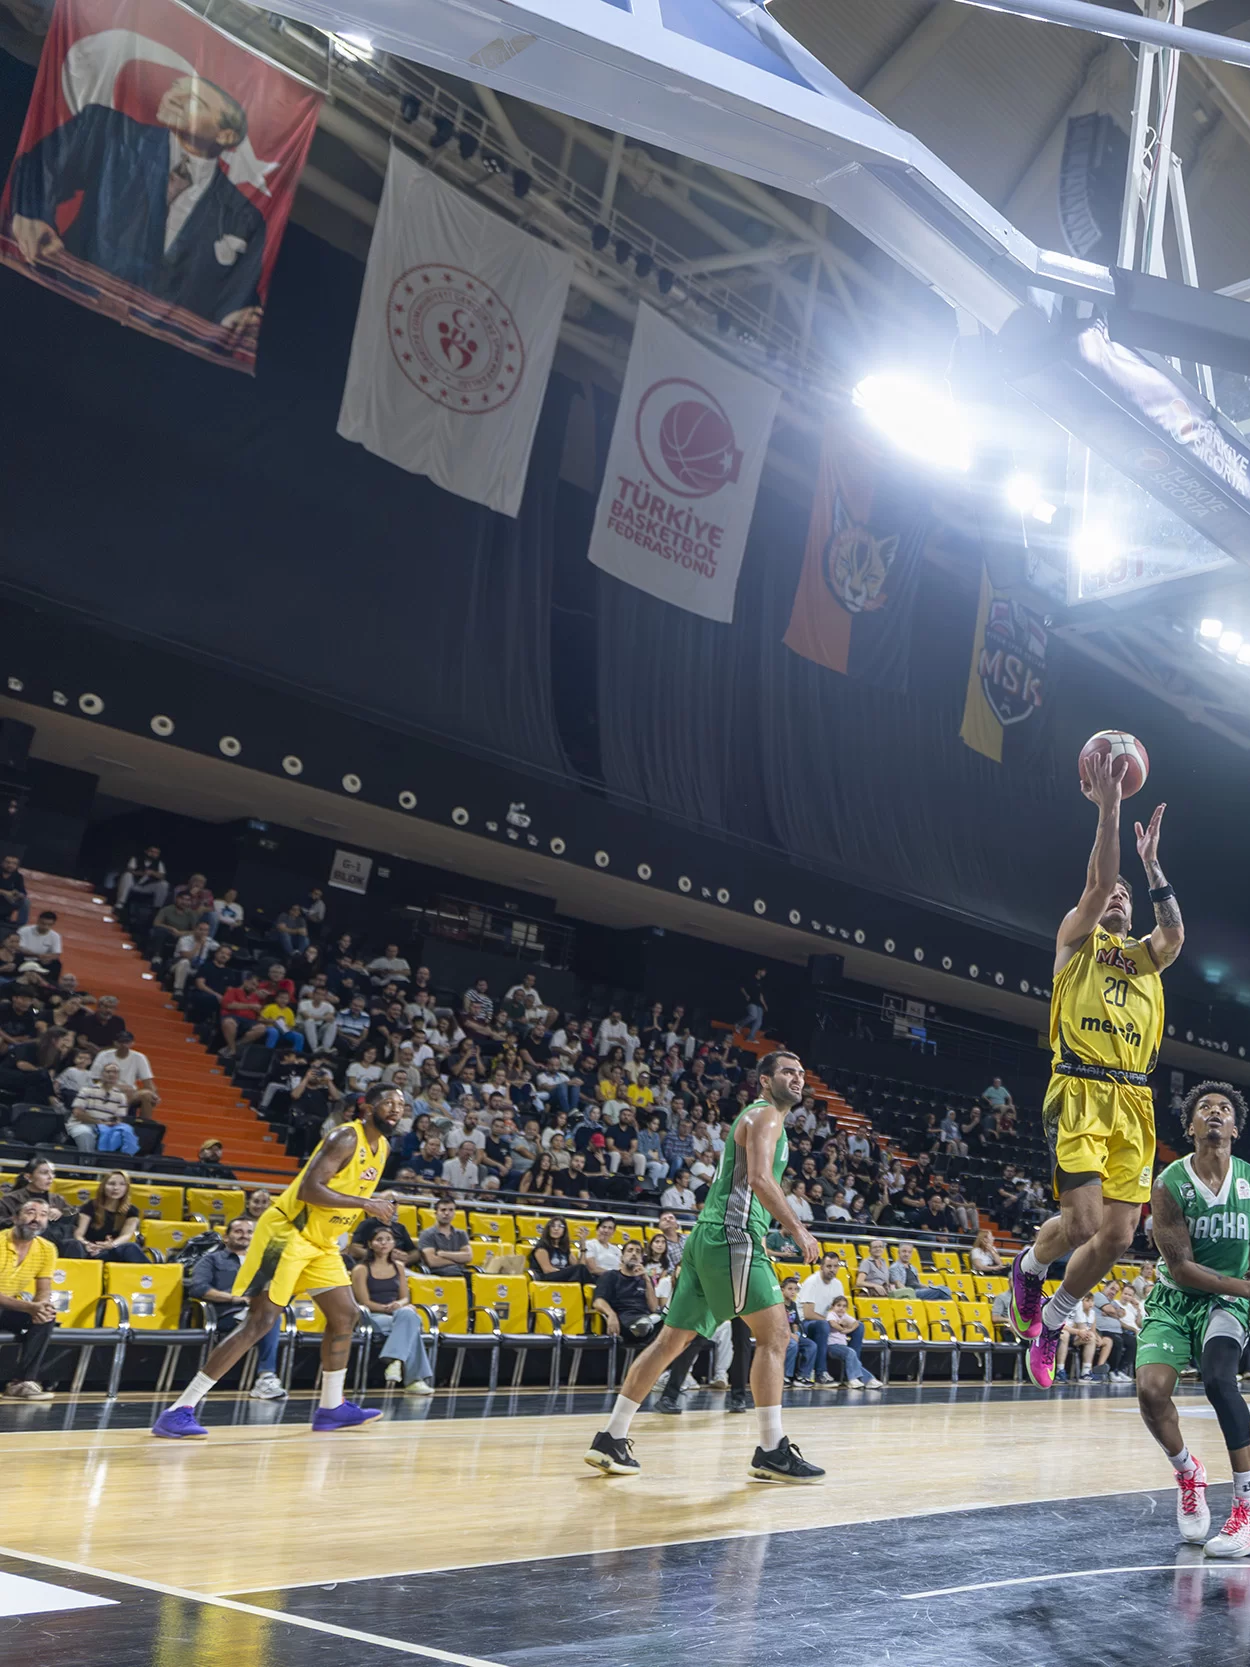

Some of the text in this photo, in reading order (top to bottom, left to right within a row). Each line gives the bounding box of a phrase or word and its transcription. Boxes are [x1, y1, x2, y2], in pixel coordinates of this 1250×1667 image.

[611, 498, 718, 566] BASKETBOL
[617, 476, 724, 549] TÜRKİYE
[607, 515, 716, 579] FEDERASYONU
[978, 647, 1043, 706] MSK
[1103, 976, 1129, 1007] 20
